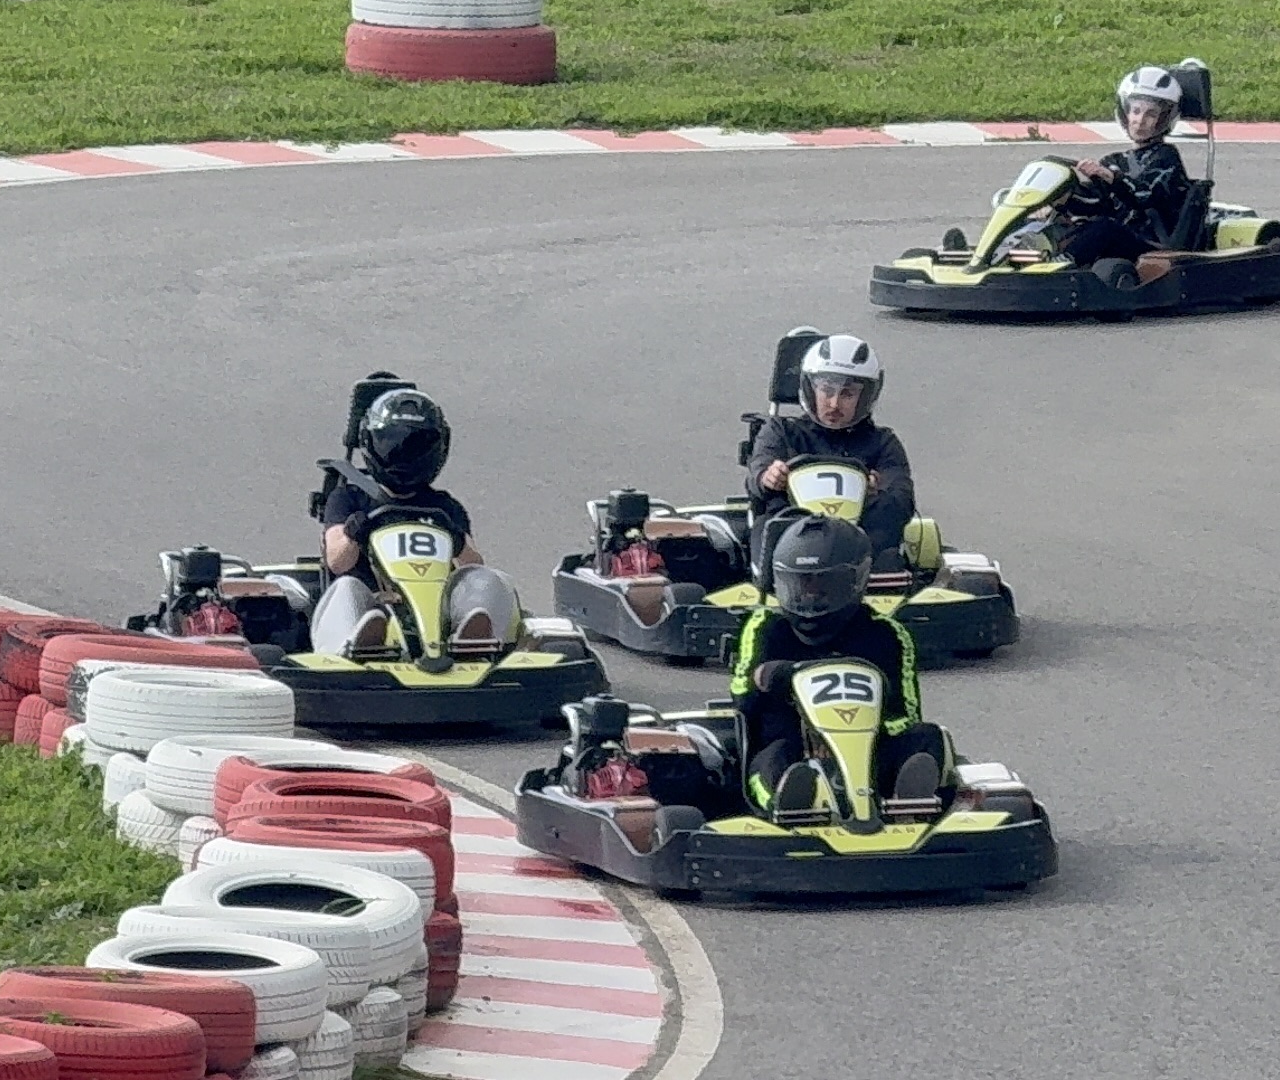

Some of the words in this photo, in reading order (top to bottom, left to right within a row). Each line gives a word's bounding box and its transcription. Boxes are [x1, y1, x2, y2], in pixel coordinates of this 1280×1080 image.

[1025, 167, 1043, 186] 1
[816, 472, 844, 496] 7
[397, 531, 438, 558] 18
[810, 671, 874, 705] 25
